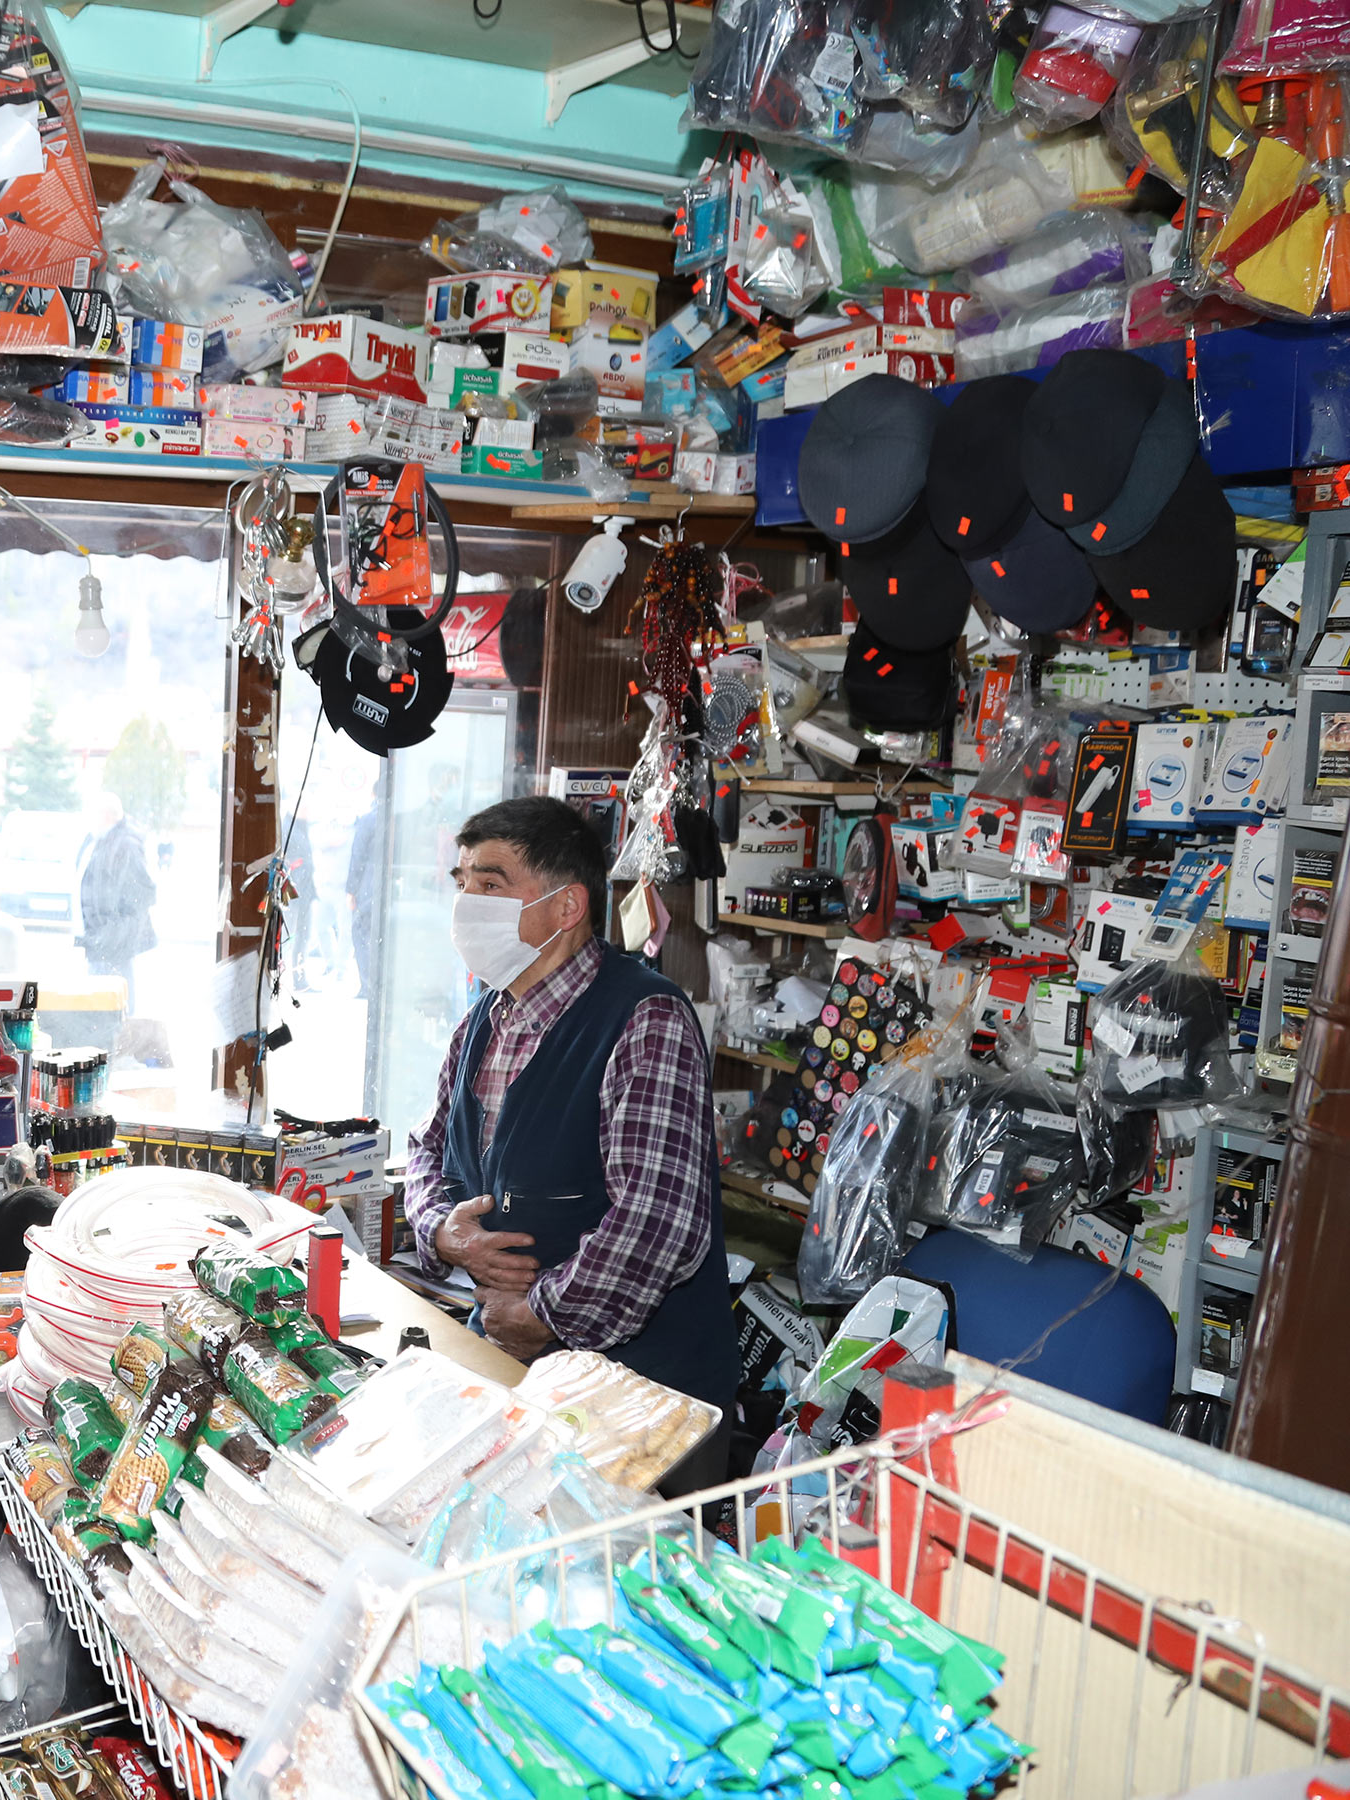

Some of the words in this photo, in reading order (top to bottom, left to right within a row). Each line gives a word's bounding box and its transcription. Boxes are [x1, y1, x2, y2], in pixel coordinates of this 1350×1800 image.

[104, 306, 113, 337] REAL
[367, 332, 417, 372] Tiryaki
[525, 341, 552, 355] eds
[355, 699, 386, 725] PLATT
[740, 843, 798, 854] SUBZERO
[1137, 1255, 1163, 1272] Excellent
[51, 1740, 76, 1768] halley
